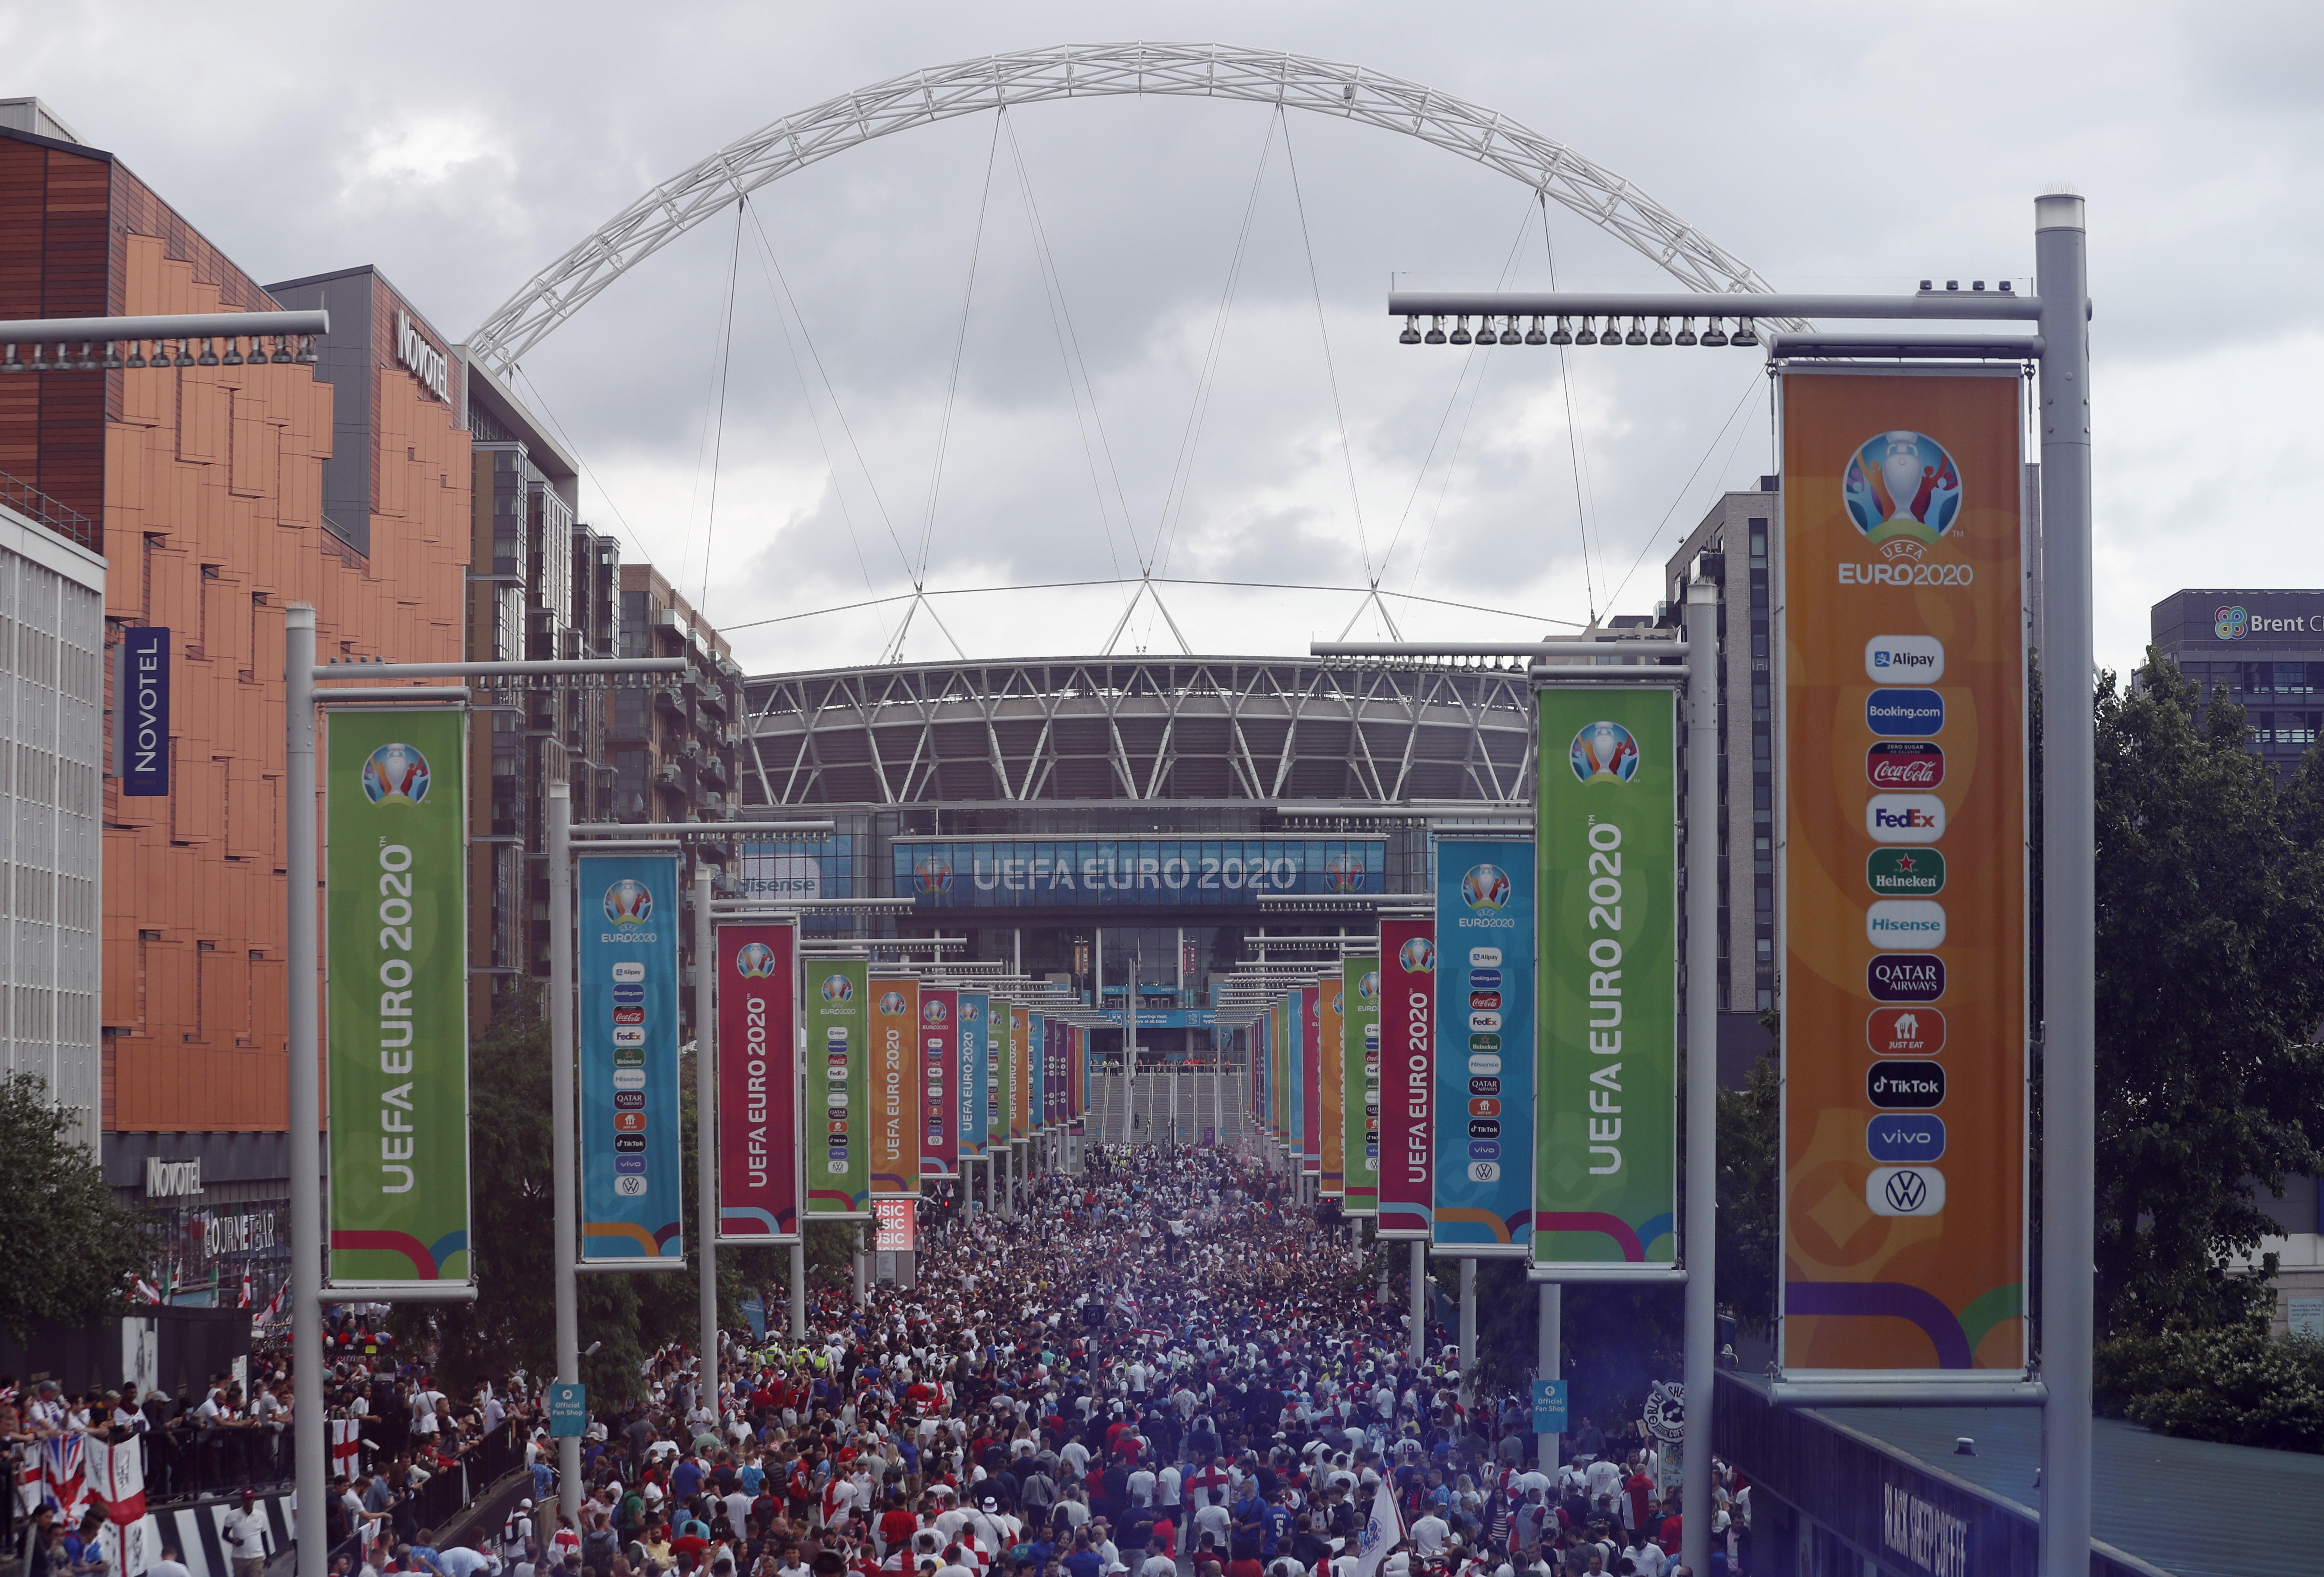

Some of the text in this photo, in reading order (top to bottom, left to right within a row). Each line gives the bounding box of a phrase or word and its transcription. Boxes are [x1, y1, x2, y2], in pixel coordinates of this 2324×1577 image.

[397, 308, 451, 405] NOVOTEL
[1882, 543, 1924, 561] UEFA
[1838, 562, 1973, 586] EURO2020
[2251, 616, 2304, 631] Brent
[1893, 653, 1934, 667] Alipay
[135, 638, 157, 771] NOVOTEL
[1870, 706, 1940, 718] Booking.com
[1886, 743, 1903, 751] ZERO
[1876, 809, 1935, 827] FedEx
[972, 857, 1079, 891] UEFA
[1083, 856, 1191, 891] EURO
[1196, 856, 1297, 889] 2020
[1876, 875, 1937, 887] Heineken
[1459, 918, 1515, 928] EURO2020
[1872, 919, 1940, 930] Hisense
[601, 933, 657, 942] EURO2020
[1875, 964, 1937, 981] QATAR
[1890, 981, 1937, 991] AIRWAYS
[1588, 824, 1622, 1175] UEFA EURO 2020
[379, 844, 414, 1193] UEFA EURO 2020
[963, 1031, 973, 1131] UEFA EURO 2020
[1408, 992, 1428, 1182] UEFA EURO 2020
[1890, 1080, 1938, 1092] TikTok
[617, 1095, 642, 1103] QATAR
[747, 997, 767, 1187] UEFA EURO 2020
[886, 1030, 900, 1160] UEFA EURO 2020
[1882, 1130, 1930, 1143] vivo
[146, 1156, 204, 1198] NOVOTEL
[1353, 1386, 1361, 1397] 6
[988, 1443, 1003, 1452] ENGLAND
[1275, 1519, 1284, 1538] 5
[1884, 1482, 1967, 1577] BLACK SHEEP COFFEE
